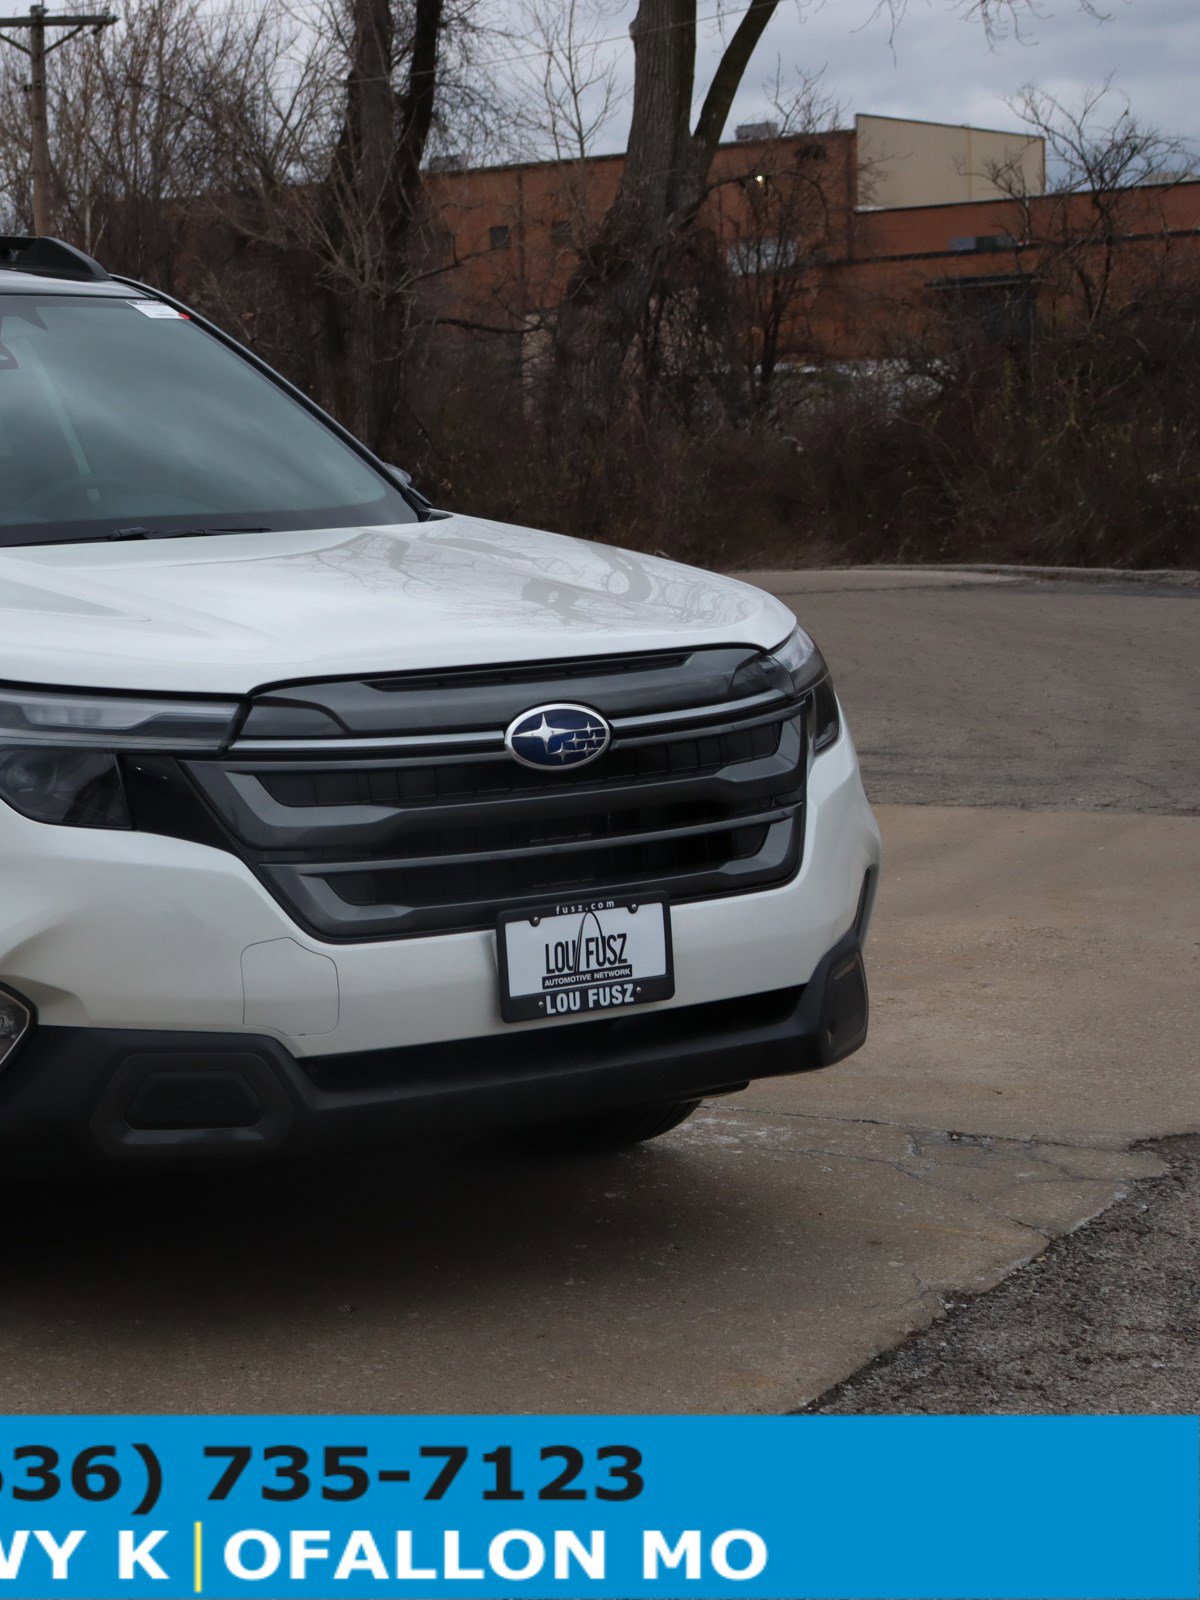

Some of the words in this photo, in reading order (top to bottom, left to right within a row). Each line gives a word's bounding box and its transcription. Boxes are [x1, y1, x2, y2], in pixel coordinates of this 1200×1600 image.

[555, 900, 615, 915] fusz.com
[545, 940, 577, 975] LOU
[585, 933, 627, 969] FUSZ
[544, 973, 592, 988] AUTOMOTIVE
[593, 967, 631, 980] NETWORK
[545, 990, 581, 1015] LOU
[588, 983, 635, 1008] FUSZ
